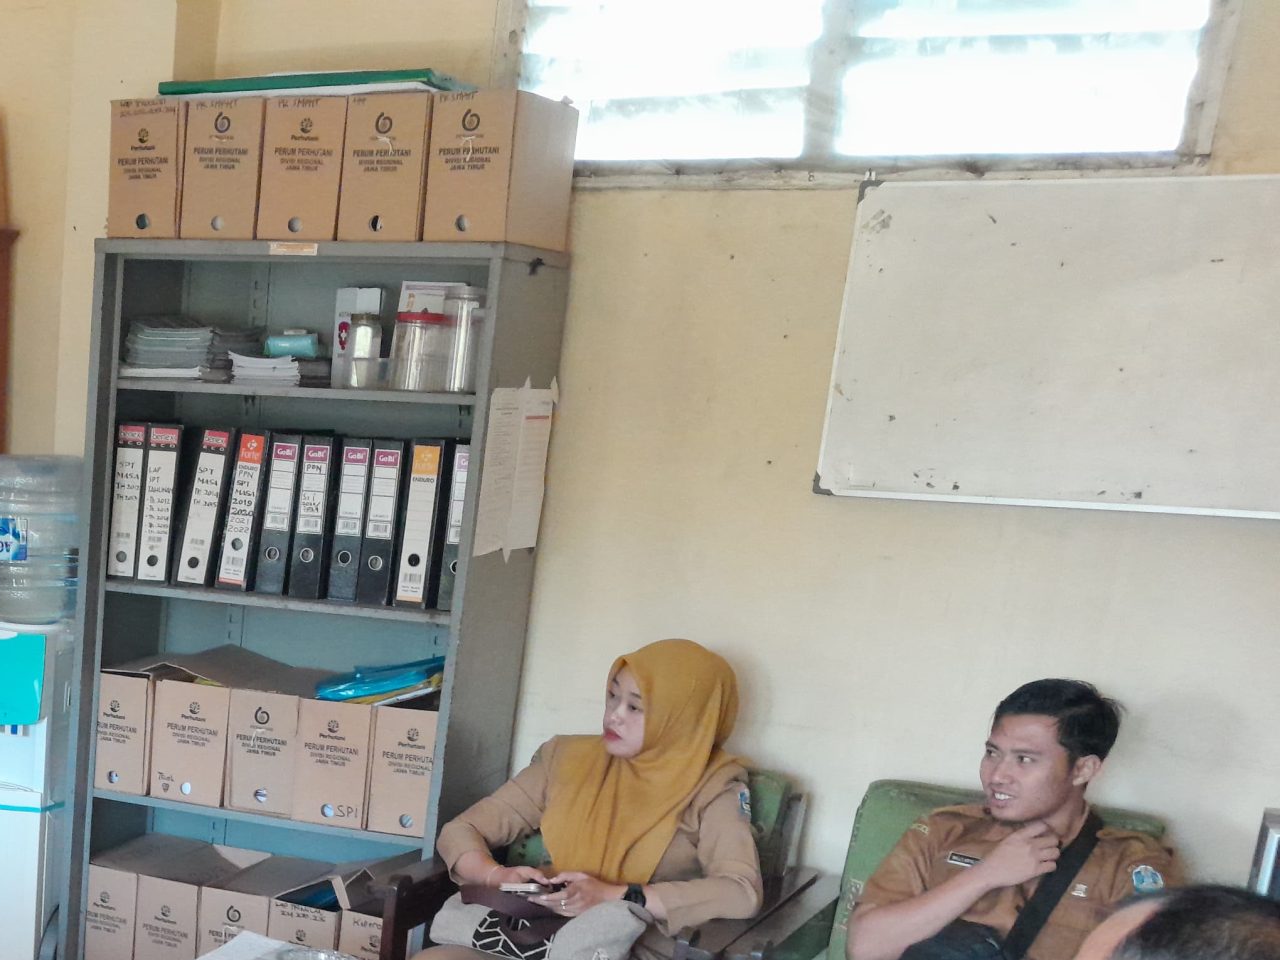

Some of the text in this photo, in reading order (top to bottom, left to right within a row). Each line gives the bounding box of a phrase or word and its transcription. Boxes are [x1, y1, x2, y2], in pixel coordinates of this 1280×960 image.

[232, 498, 253, 507] 2019
[231, 507, 254, 517] 2020
[229, 516, 250, 525] 2021
[227, 525, 250, 534] 2022
[166, 722, 218, 737] PERUM PERHUTANI
[304, 742, 359, 756] PERUM PERHUTANI
[382, 750, 404, 760] PERUM
